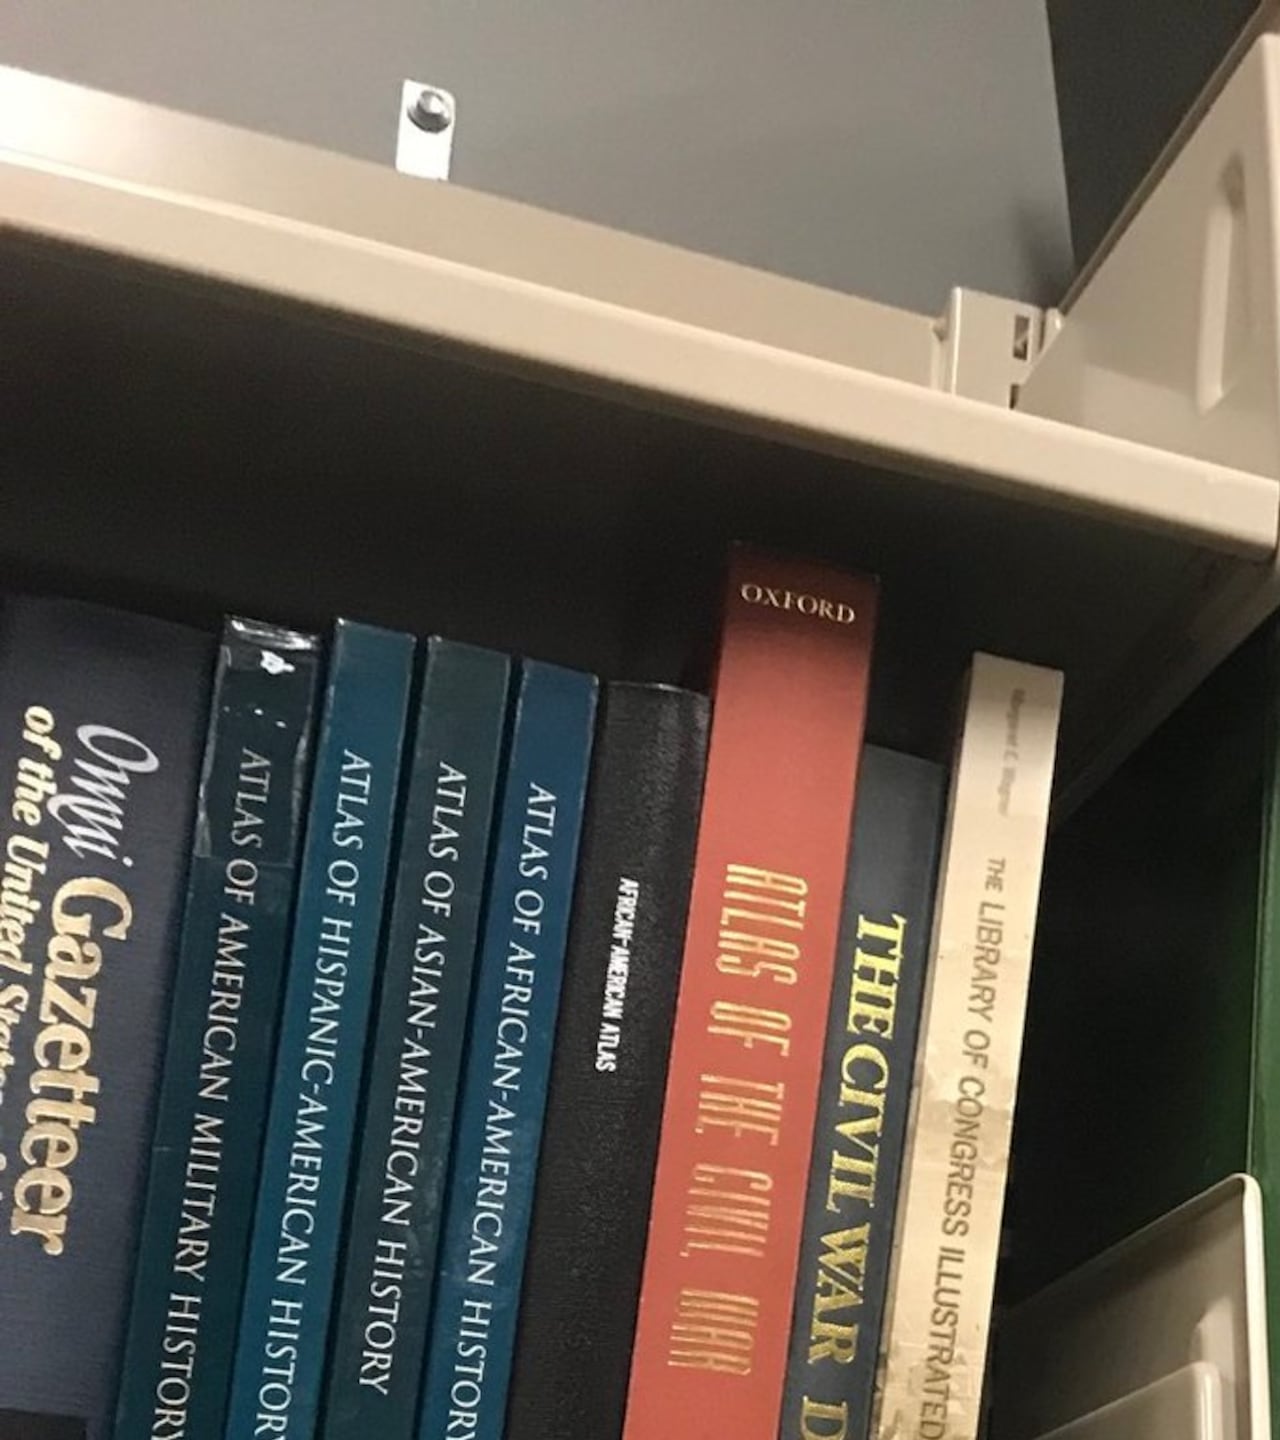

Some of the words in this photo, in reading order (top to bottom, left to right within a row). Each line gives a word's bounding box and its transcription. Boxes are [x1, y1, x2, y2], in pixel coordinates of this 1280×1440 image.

[741, 583, 855, 625] OXFORD
[24, 705, 63, 758] of
[12, 761, 57, 826] the
[47, 724, 160, 868] Omni
[229, 747, 271, 851] ATLAS
[328, 748, 372, 850] ATLAS
[428, 760, 468, 861] ATLAS
[516, 781, 557, 882] ATLAS
[225, 859, 259, 907] OF
[322, 861, 360, 908] OF
[422, 870, 457, 918] OF
[511, 893, 545, 936] OF
[714, 862, 809, 986] ATLAS
[984, 856, 1006, 893] THE
[604, 877, 640, 1024] AFRICAN-AMERICAN
[846, 914, 907, 1039] THE
[968, 901, 1004, 1022] LIBRARY
[198, 912, 249, 1103] AMERICAN
[596, 1022, 621, 1073] ATLAS
[707, 1001, 792, 1057] OF
[962, 1029, 992, 1071] OF
[10, 876, 133, 1256] Gazetteer
[275, 915, 353, 1285] HISPANIC-AMERICAN
[383, 923, 453, 1228] ASIAN-AMERICAN
[467, 941, 536, 1287] AFRICAN-AMERICAN
[695, 1073, 784, 1146] THE
[827, 1043, 890, 1213] CIVIL
[940, 1076, 987, 1237] CONGRESS
[168, 1112, 225, 1284] MILITARY
[680, 1164, 773, 1258] CIVIL
[358, 1238, 400, 1396] HISTORY
[668, 1288, 758, 1376] WAR
[808, 1223, 871, 1365] WAR
[919, 1246, 966, 1440] ILLUSTRATED
